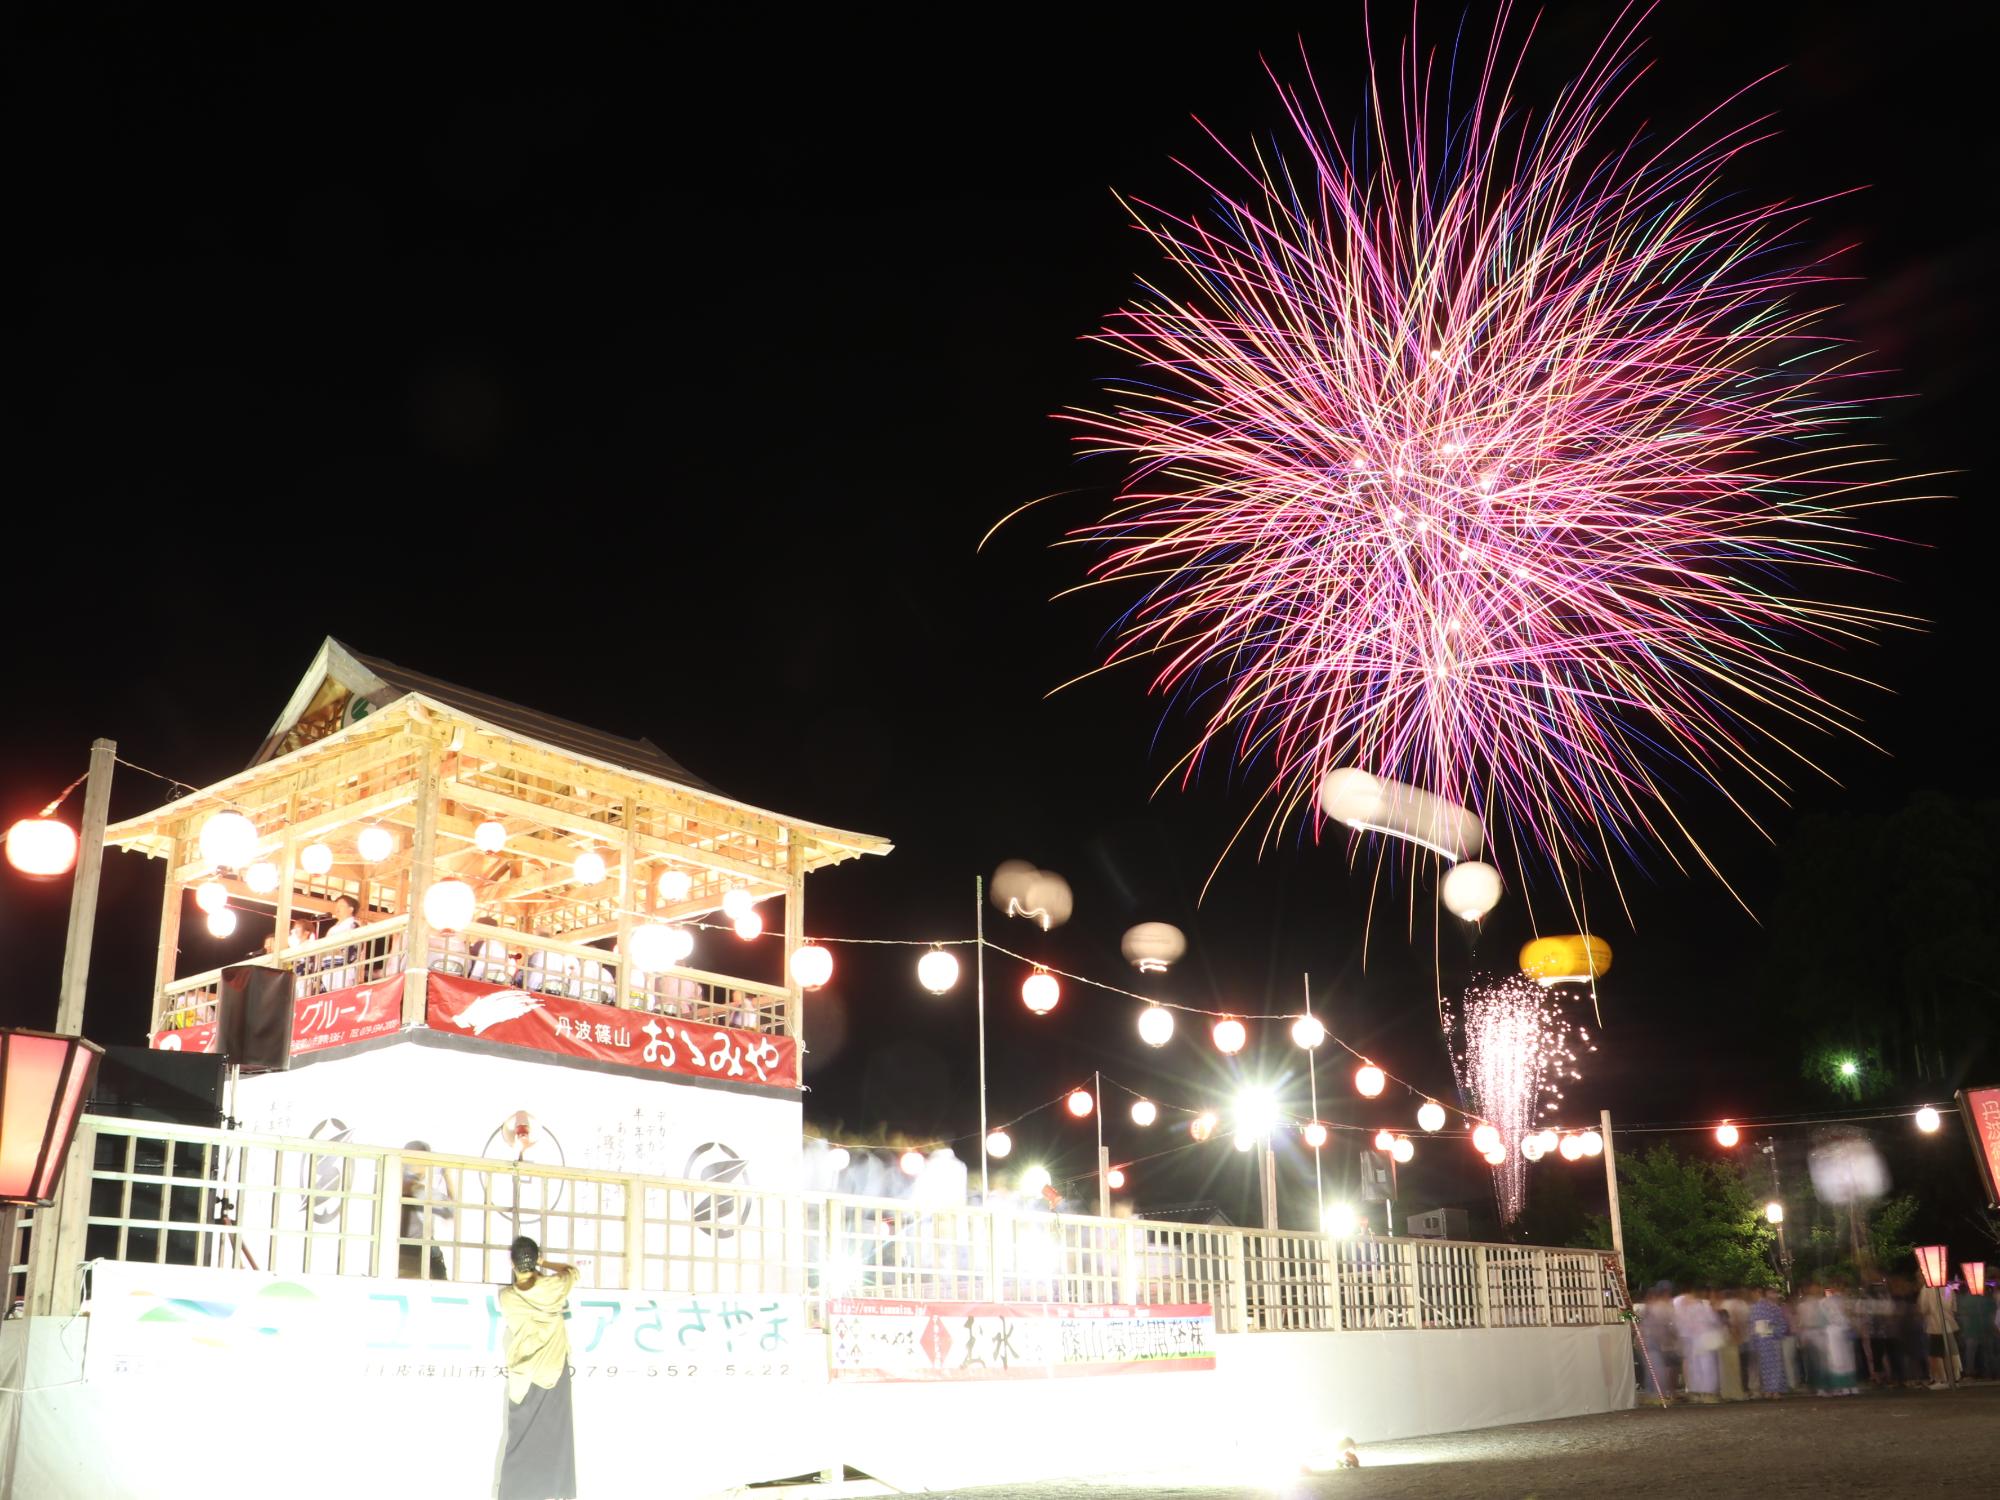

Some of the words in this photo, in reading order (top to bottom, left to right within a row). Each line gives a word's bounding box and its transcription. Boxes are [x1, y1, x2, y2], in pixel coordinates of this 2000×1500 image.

[554, 1016, 631, 1048] 丹波篠山
[366, 1293, 789, 1353] ユニトアささやま
